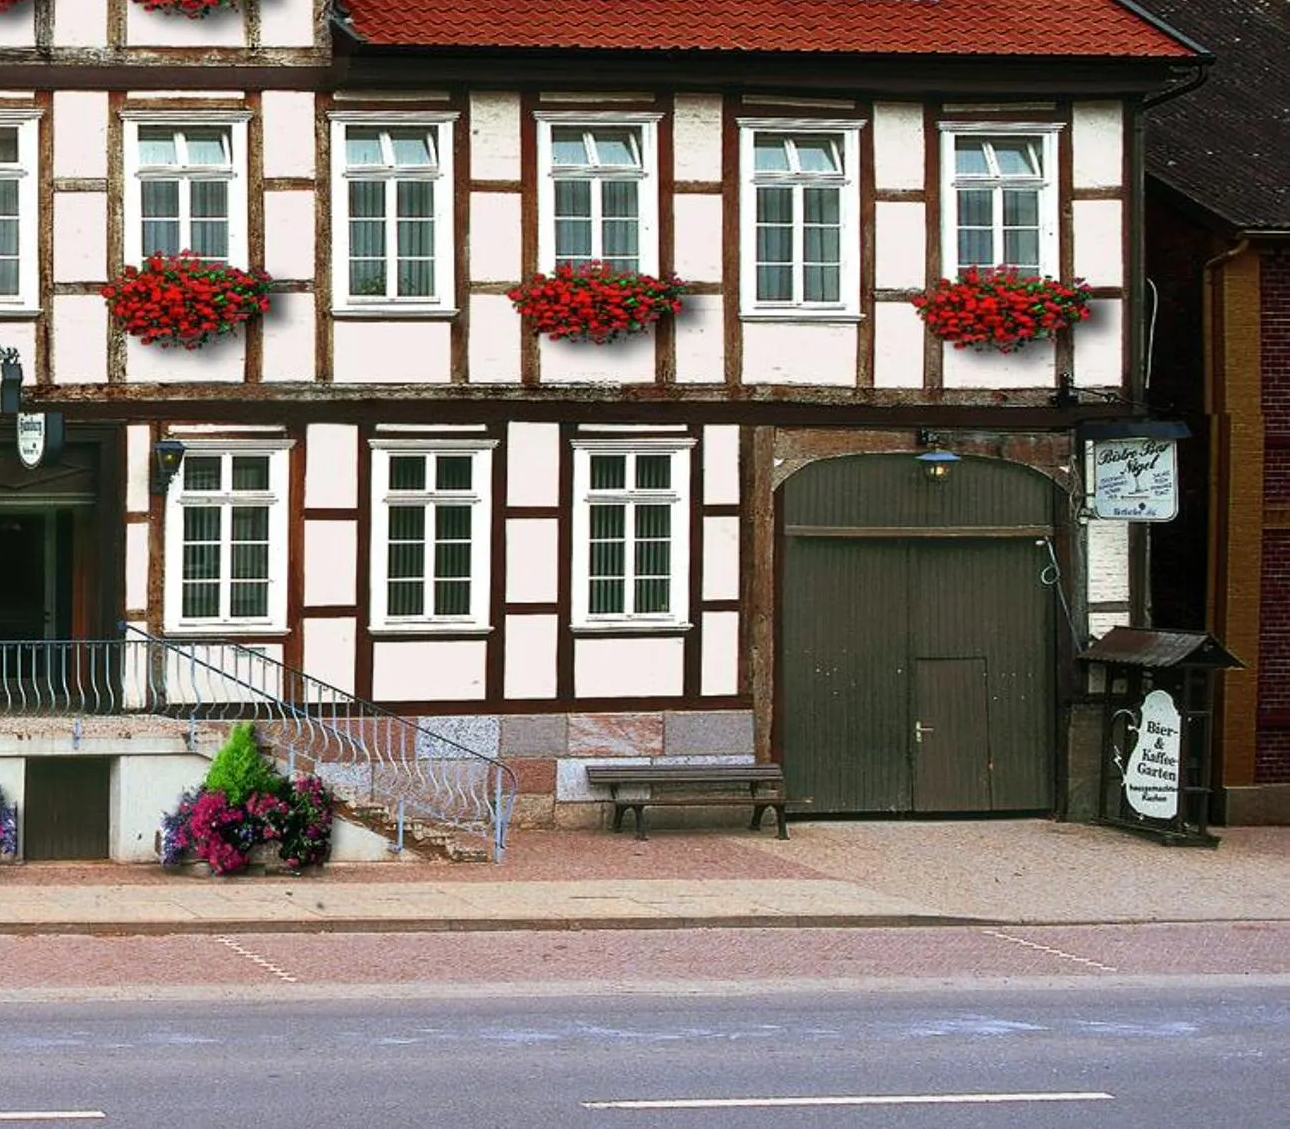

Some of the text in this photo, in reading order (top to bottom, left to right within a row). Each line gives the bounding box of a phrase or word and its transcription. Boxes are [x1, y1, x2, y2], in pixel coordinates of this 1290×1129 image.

[1120, 454, 1160, 477] Nigel
[1147, 721, 1178, 737] Bier-
[1154, 737, 1165, 750] &
[1137, 762, 1176, 781] Garten
